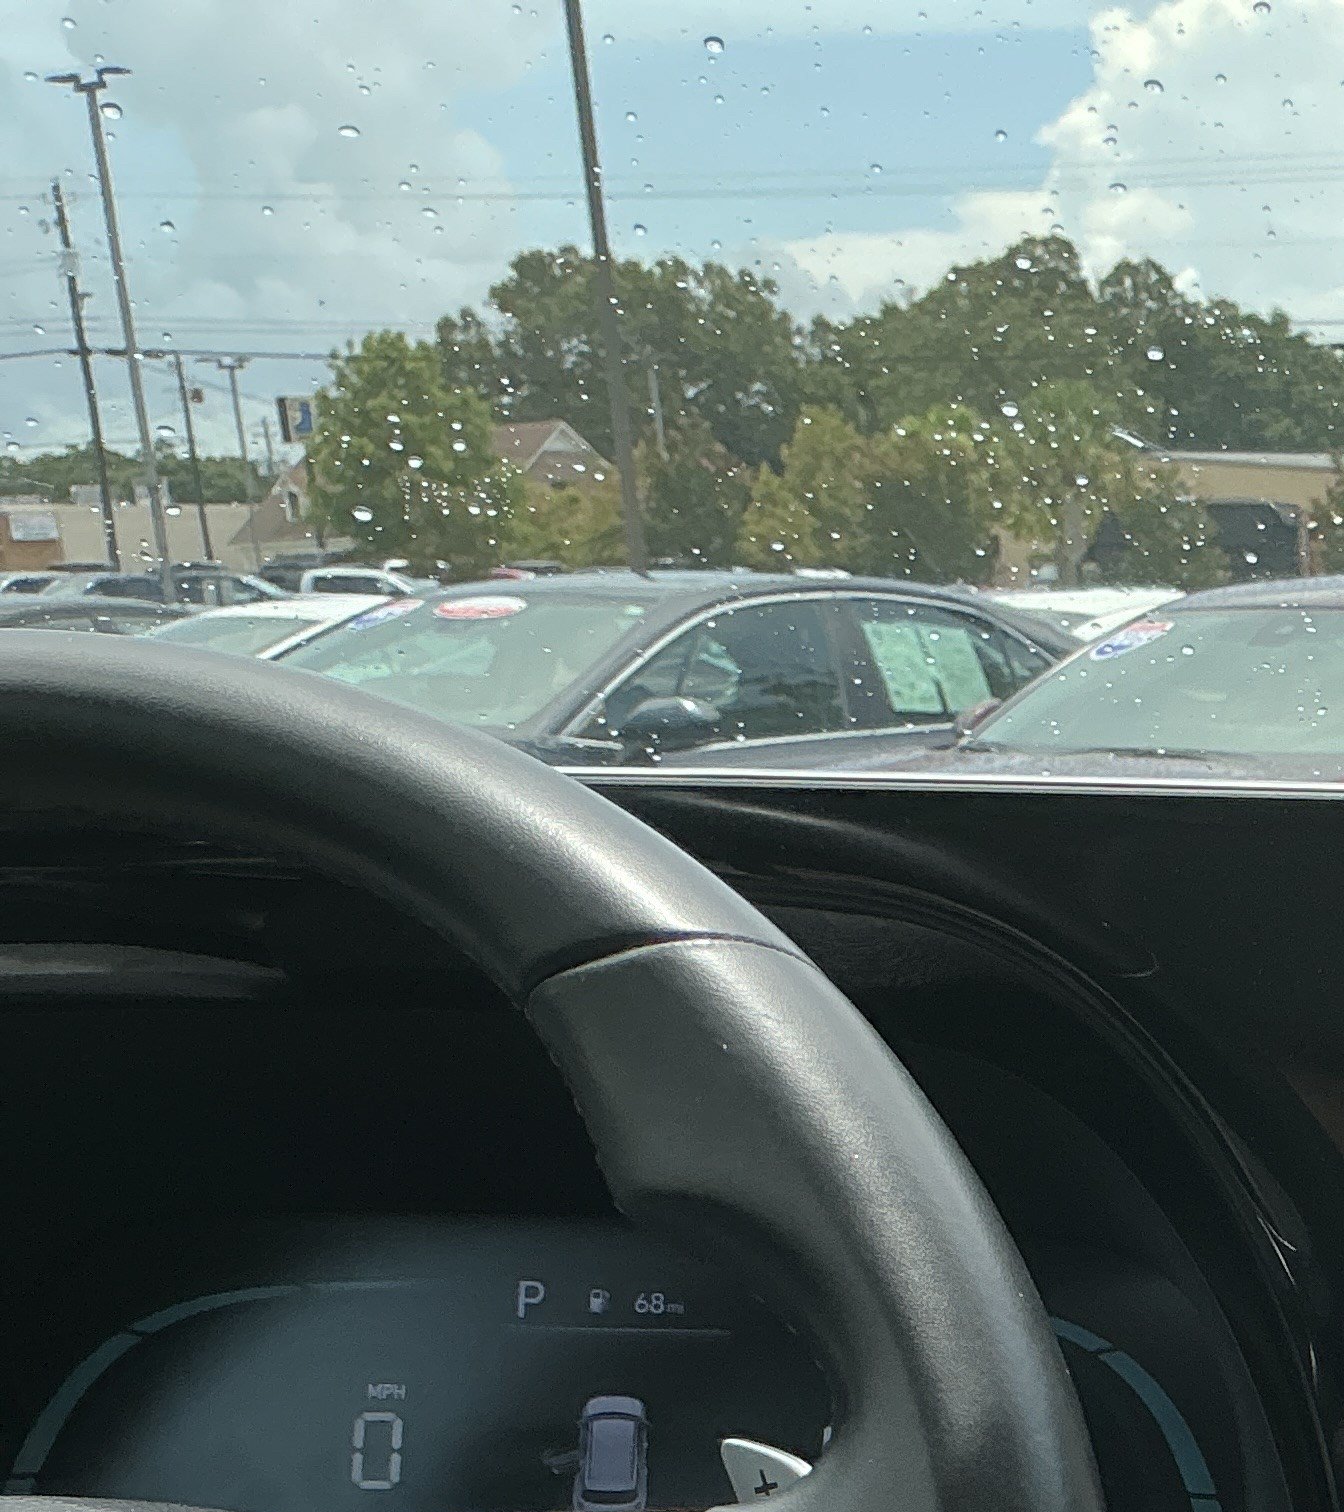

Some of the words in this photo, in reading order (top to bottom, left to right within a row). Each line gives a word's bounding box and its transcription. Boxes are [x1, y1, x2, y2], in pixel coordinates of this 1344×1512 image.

[517, 1280, 546, 1319] P
[635, 1292, 665, 1314] 68
[368, 1383, 406, 1400] MPH
[351, 1411, 404, 1490] 0
